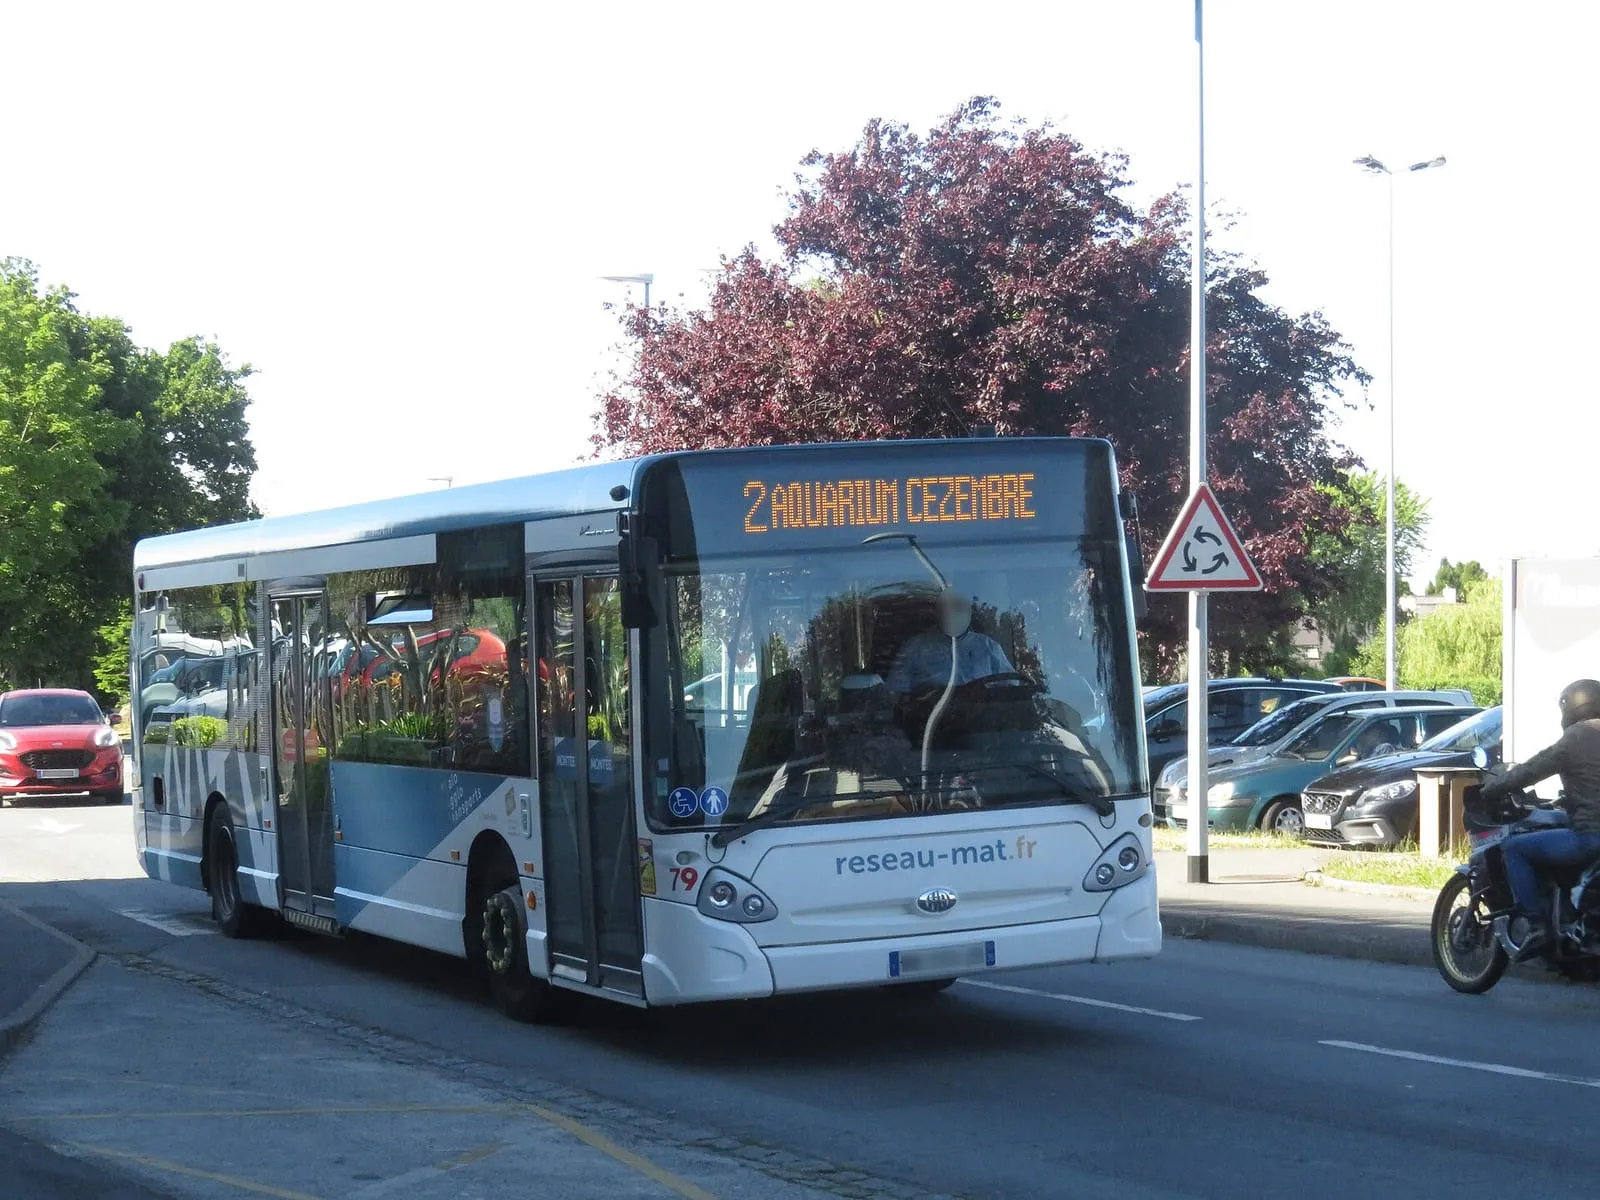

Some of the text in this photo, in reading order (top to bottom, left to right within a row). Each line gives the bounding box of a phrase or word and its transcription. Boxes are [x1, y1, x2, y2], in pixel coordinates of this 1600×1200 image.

[743, 473, 1036, 533] 2 AQUARIUM CEZEMBRE
[835, 834, 1037, 875] reseau-mat.fr
[668, 867, 699, 891] 79
